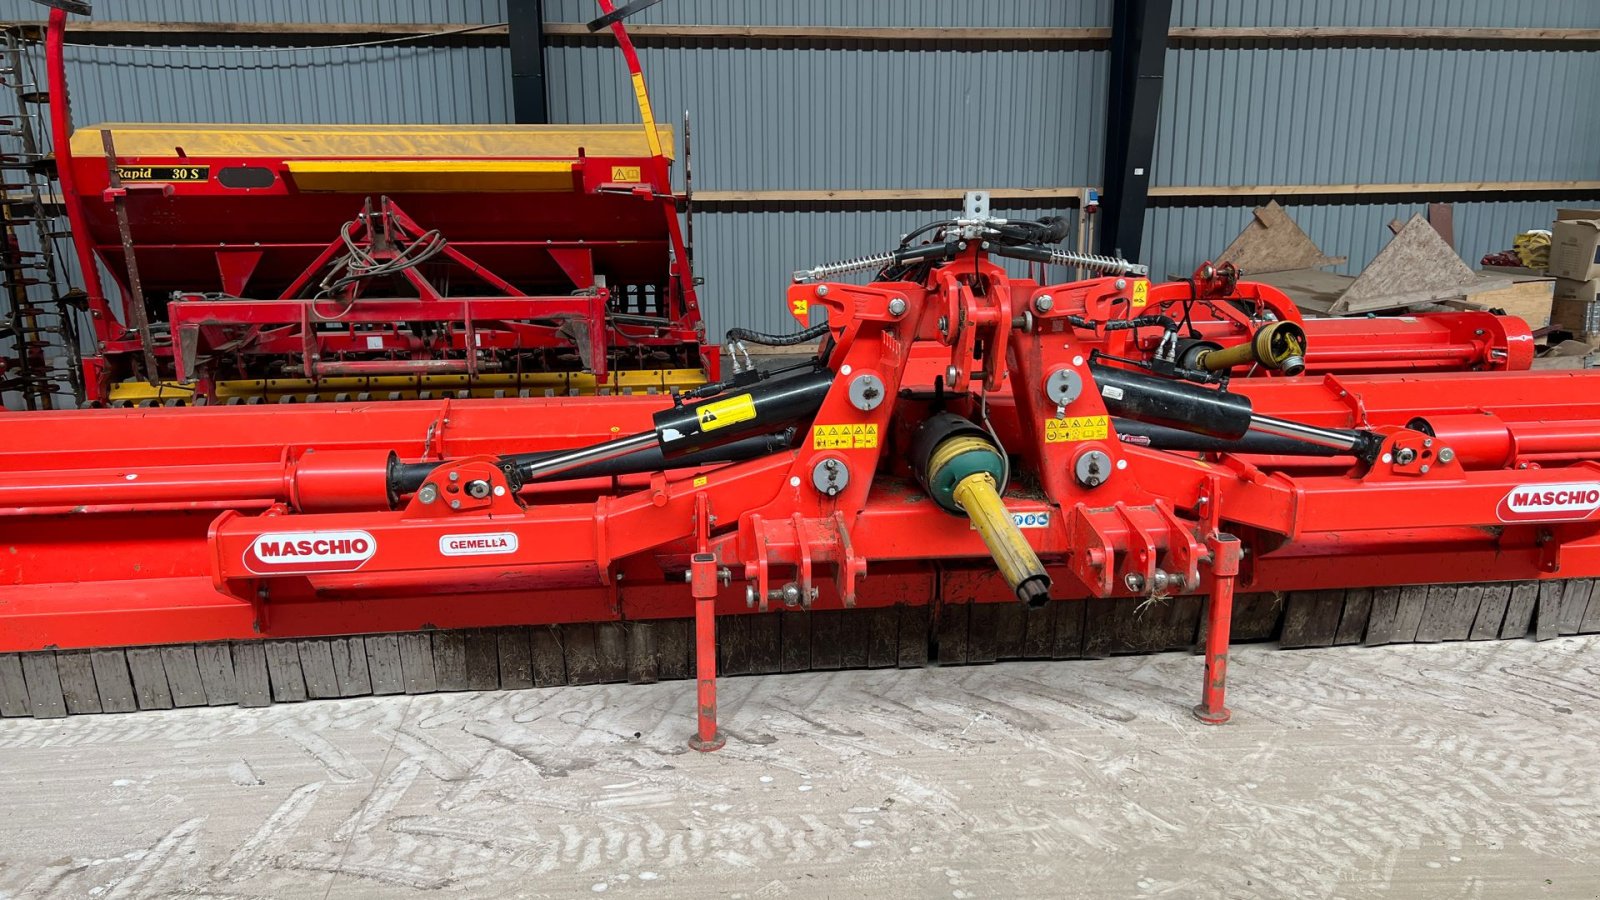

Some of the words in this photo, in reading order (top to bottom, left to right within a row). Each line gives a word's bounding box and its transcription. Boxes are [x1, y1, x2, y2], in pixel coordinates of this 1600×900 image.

[117, 167, 152, 180] Rapid
[172, 168, 188, 179] 30
[190, 168, 199, 179] S
[1512, 489, 1600, 507] MASCHIO
[260, 538, 369, 557] MASCHIO
[450, 538, 508, 550] GEMELLA
